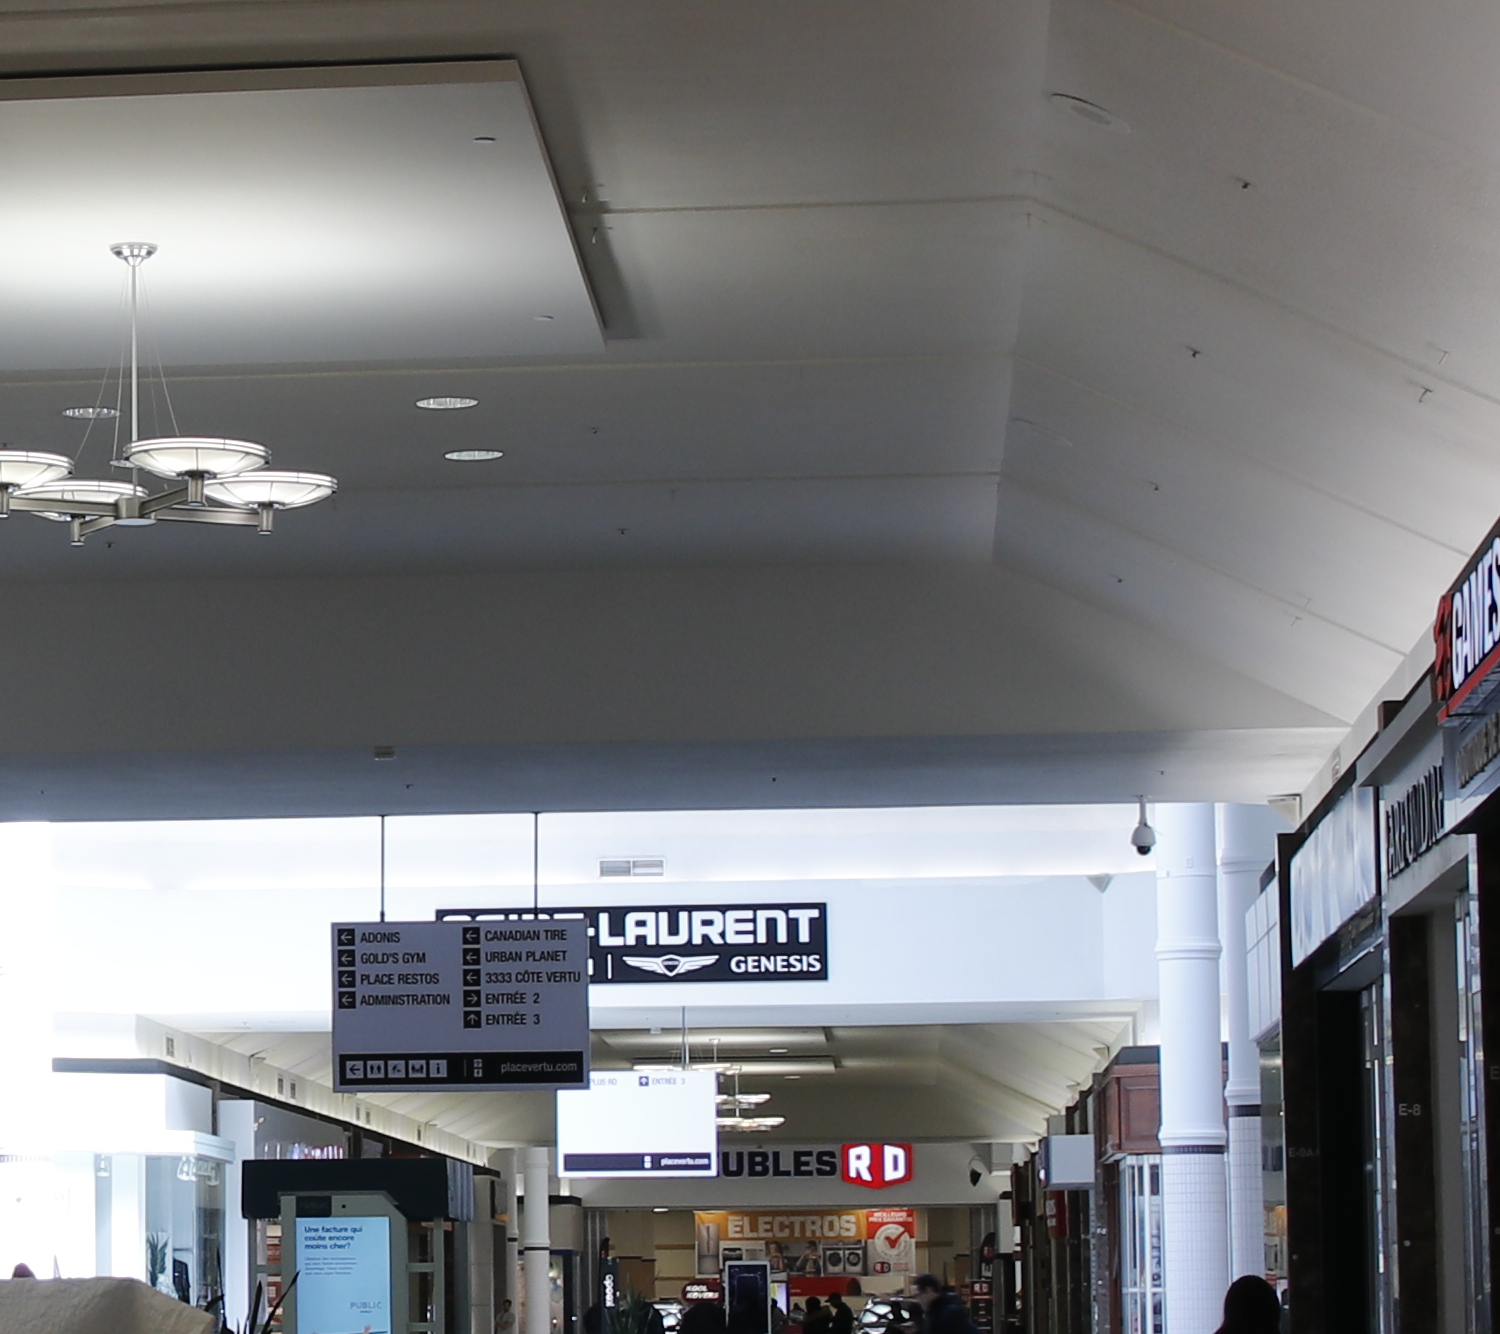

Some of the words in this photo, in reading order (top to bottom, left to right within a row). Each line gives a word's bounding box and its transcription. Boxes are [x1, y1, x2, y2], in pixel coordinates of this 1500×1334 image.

[360, 931, 400, 943] ADONIS
[484, 930, 541, 942] CANADIAN
[544, 929, 568, 941] TIRE
[361, 953, 400, 964] GOLD'S
[402, 952, 426, 964] GYM
[485, 951, 523, 962] URBAN
[526, 950, 568, 962] PLANET
[730, 954, 822, 975] GENESIS
[361, 974, 395, 985] PLACE
[398, 973, 440, 985] RESTOS
[485, 972, 512, 983] 3333
[515, 970, 543, 983] CÔTE
[546, 971, 581, 983] VERTU
[360, 994, 451, 1006] ADMINISTRATION
[486, 991, 527, 1004] ENTRÉE
[533, 993, 540, 1004] 2
[486, 1012, 527, 1025] ENTRÉE
[533, 1014, 540, 1025] 3
[501, 1061, 578, 1073] placevertu.com
[1398, 1104, 1421, 1116] E-8
[722, 1150, 838, 1178] UBLES
[847, 1144, 907, 1182] RD
[321, 1225, 348, 1233] facture
[350, 1225, 363, 1235] qui
[304, 1242, 328, 1250] moins
[329, 1242, 351, 1250] cher?
[350, 1301, 382, 1310] PUBLIC
